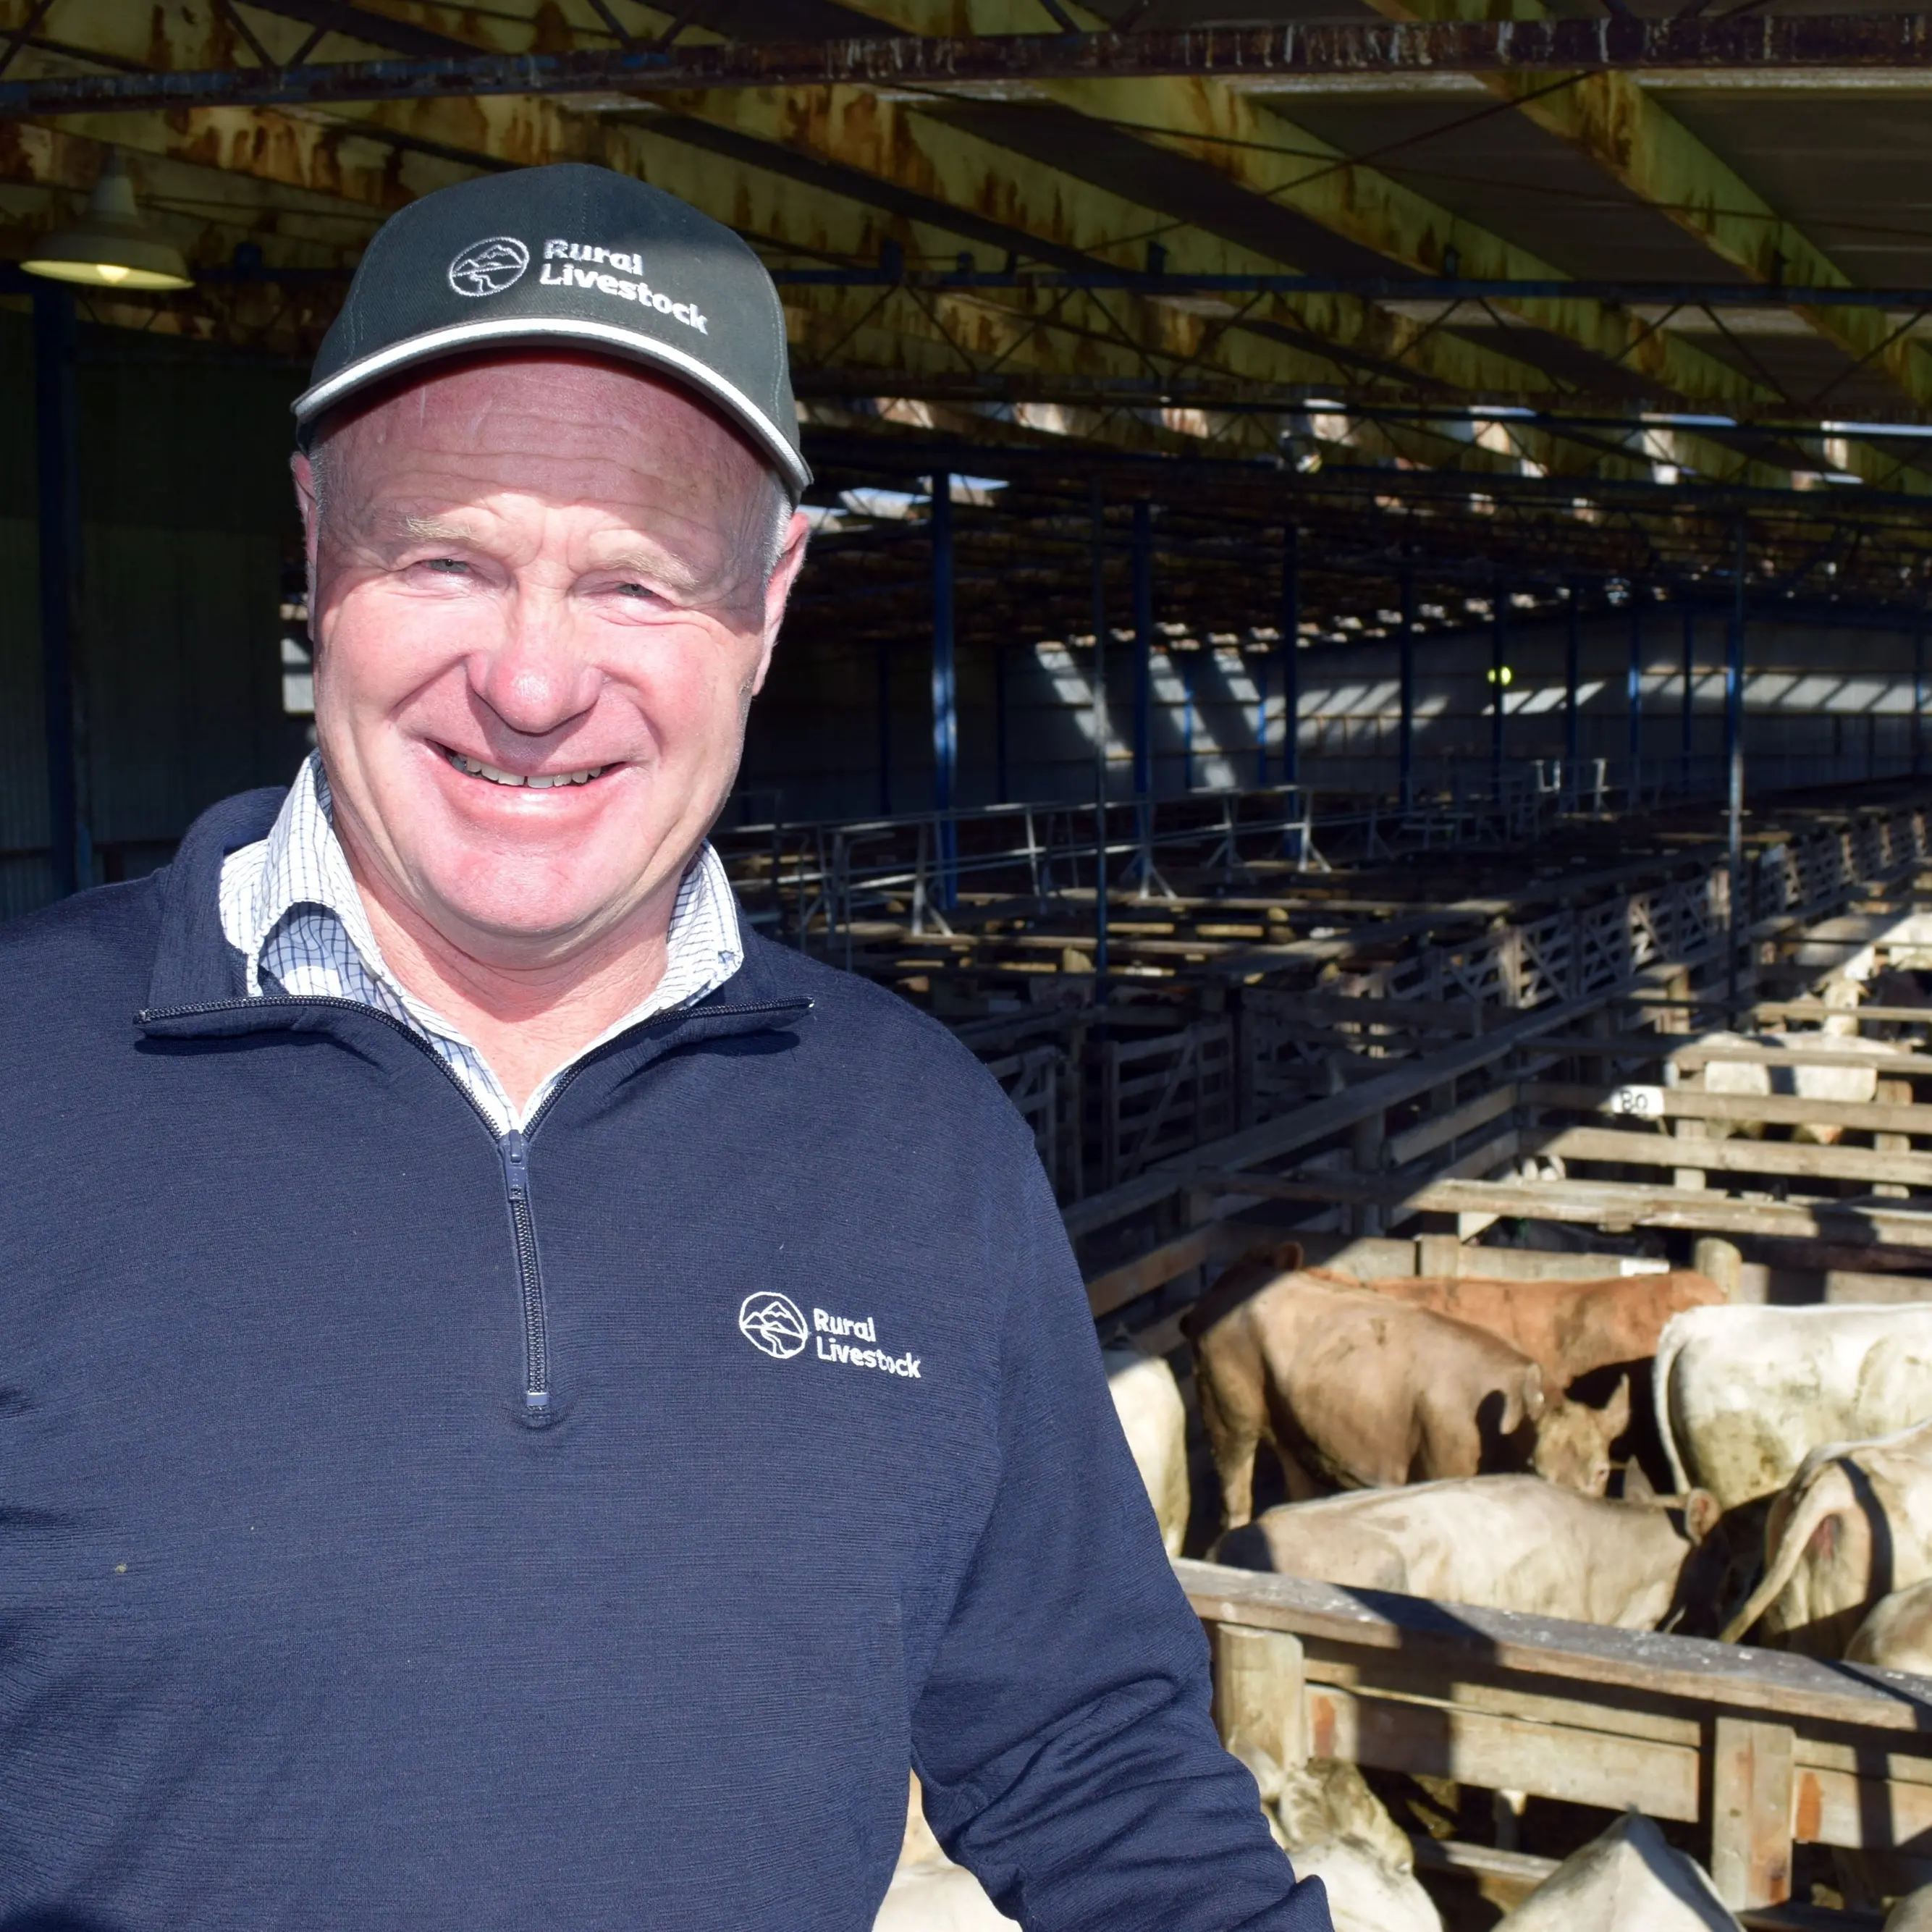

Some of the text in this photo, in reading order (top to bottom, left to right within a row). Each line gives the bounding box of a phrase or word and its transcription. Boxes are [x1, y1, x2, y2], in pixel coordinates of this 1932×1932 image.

[543, 239, 644, 276] Rural
[539, 263, 709, 335] Livestock
[814, 1308, 876, 1341] Rural
[816, 1336, 921, 1378] Livestock
